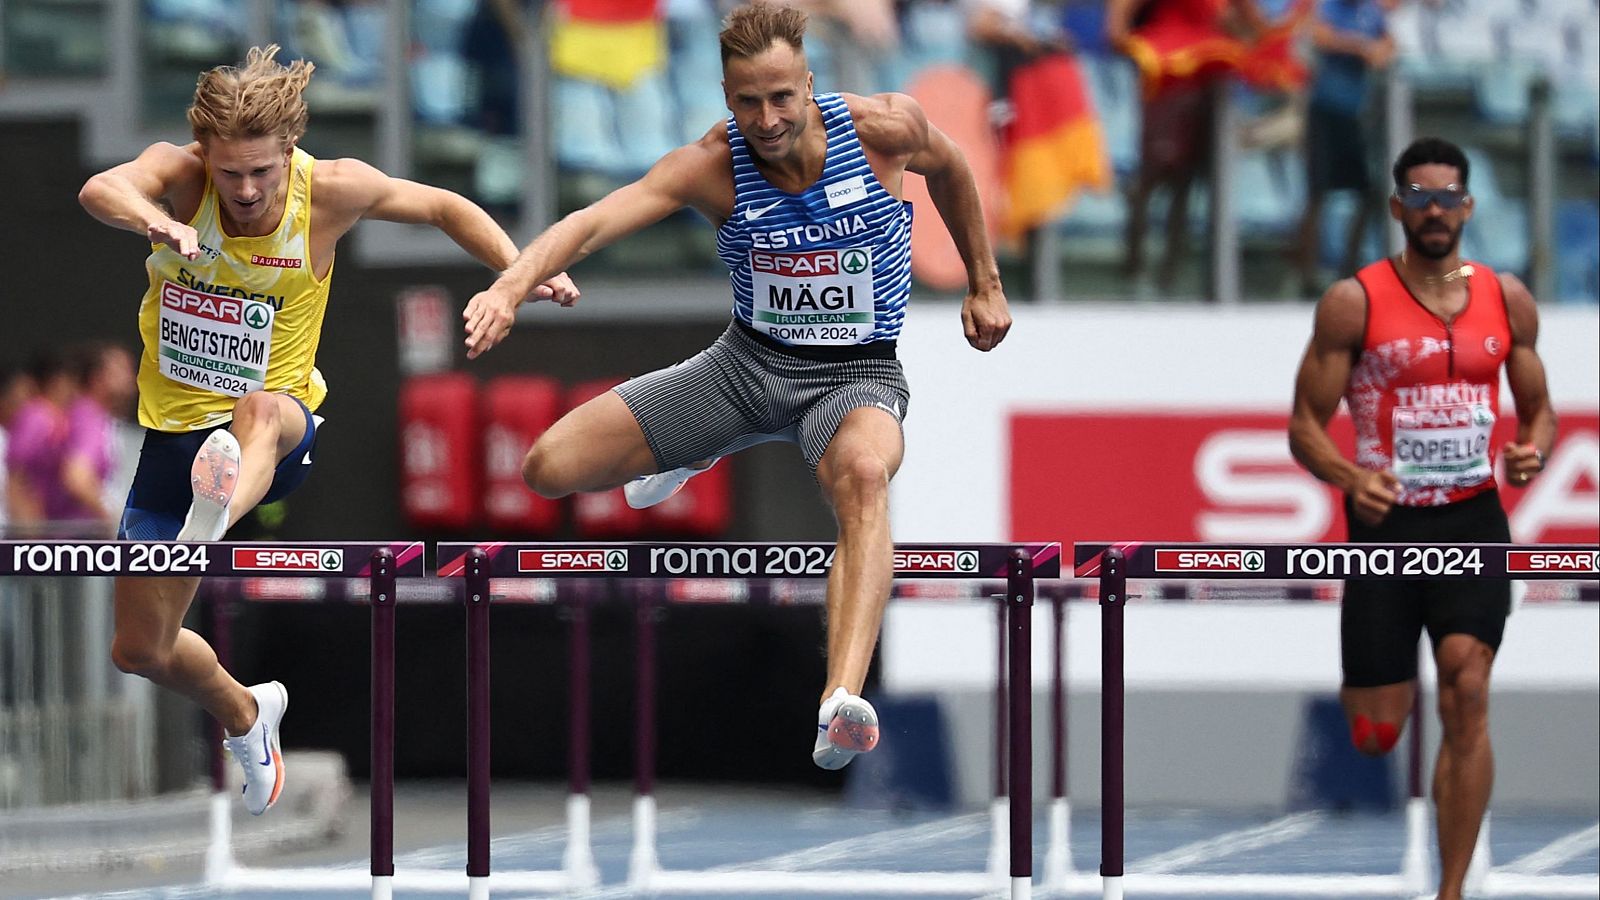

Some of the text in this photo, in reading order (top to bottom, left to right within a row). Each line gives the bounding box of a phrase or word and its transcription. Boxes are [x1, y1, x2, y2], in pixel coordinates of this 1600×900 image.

[751, 214, 868, 249] ESTONIA
[252, 255, 301, 267] BAUHAUS
[753, 254, 836, 275] SPAR
[163, 287, 240, 321] SPAR
[769, 283, 854, 311] MÄGI
[781, 315, 806, 324] RUN
[161, 317, 265, 366] BENGTSTRÖM
[769, 327, 858, 340] ROMA 2024
[182, 355, 204, 367] RUN
[170, 363, 248, 394] ROMA 2024
[1397, 434, 1486, 462] COPELLO
[1193, 429, 1599, 541] SA
[13, 544, 210, 572] roma 2024
[255, 552, 318, 567] SPAR
[540, 552, 603, 568] SPAR
[650, 547, 757, 574] roma
[894, 554, 954, 569] SPAR
[1178, 554, 1242, 569] SPAR
[1286, 548, 1485, 575] roma 2024
[1529, 554, 1592, 570] SPAR
